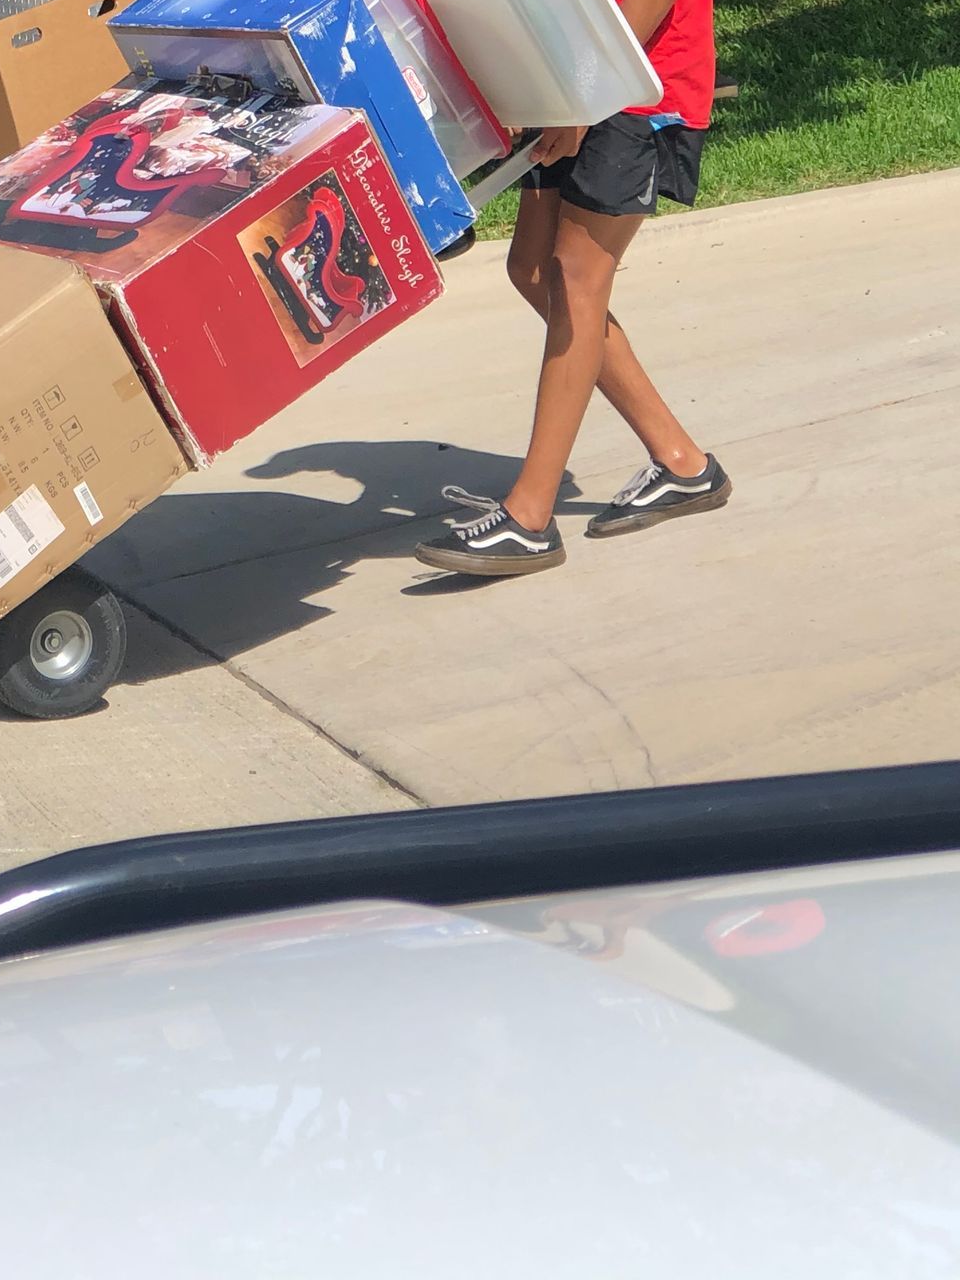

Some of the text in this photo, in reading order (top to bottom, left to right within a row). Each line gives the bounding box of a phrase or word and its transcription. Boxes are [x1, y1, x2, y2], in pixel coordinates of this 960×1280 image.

[349, 148, 424, 289] Decorative Sleigh
[32, 398, 47, 419] ITEM
[46, 480, 58, 498] KGS
[57, 471, 69, 488] PCS
